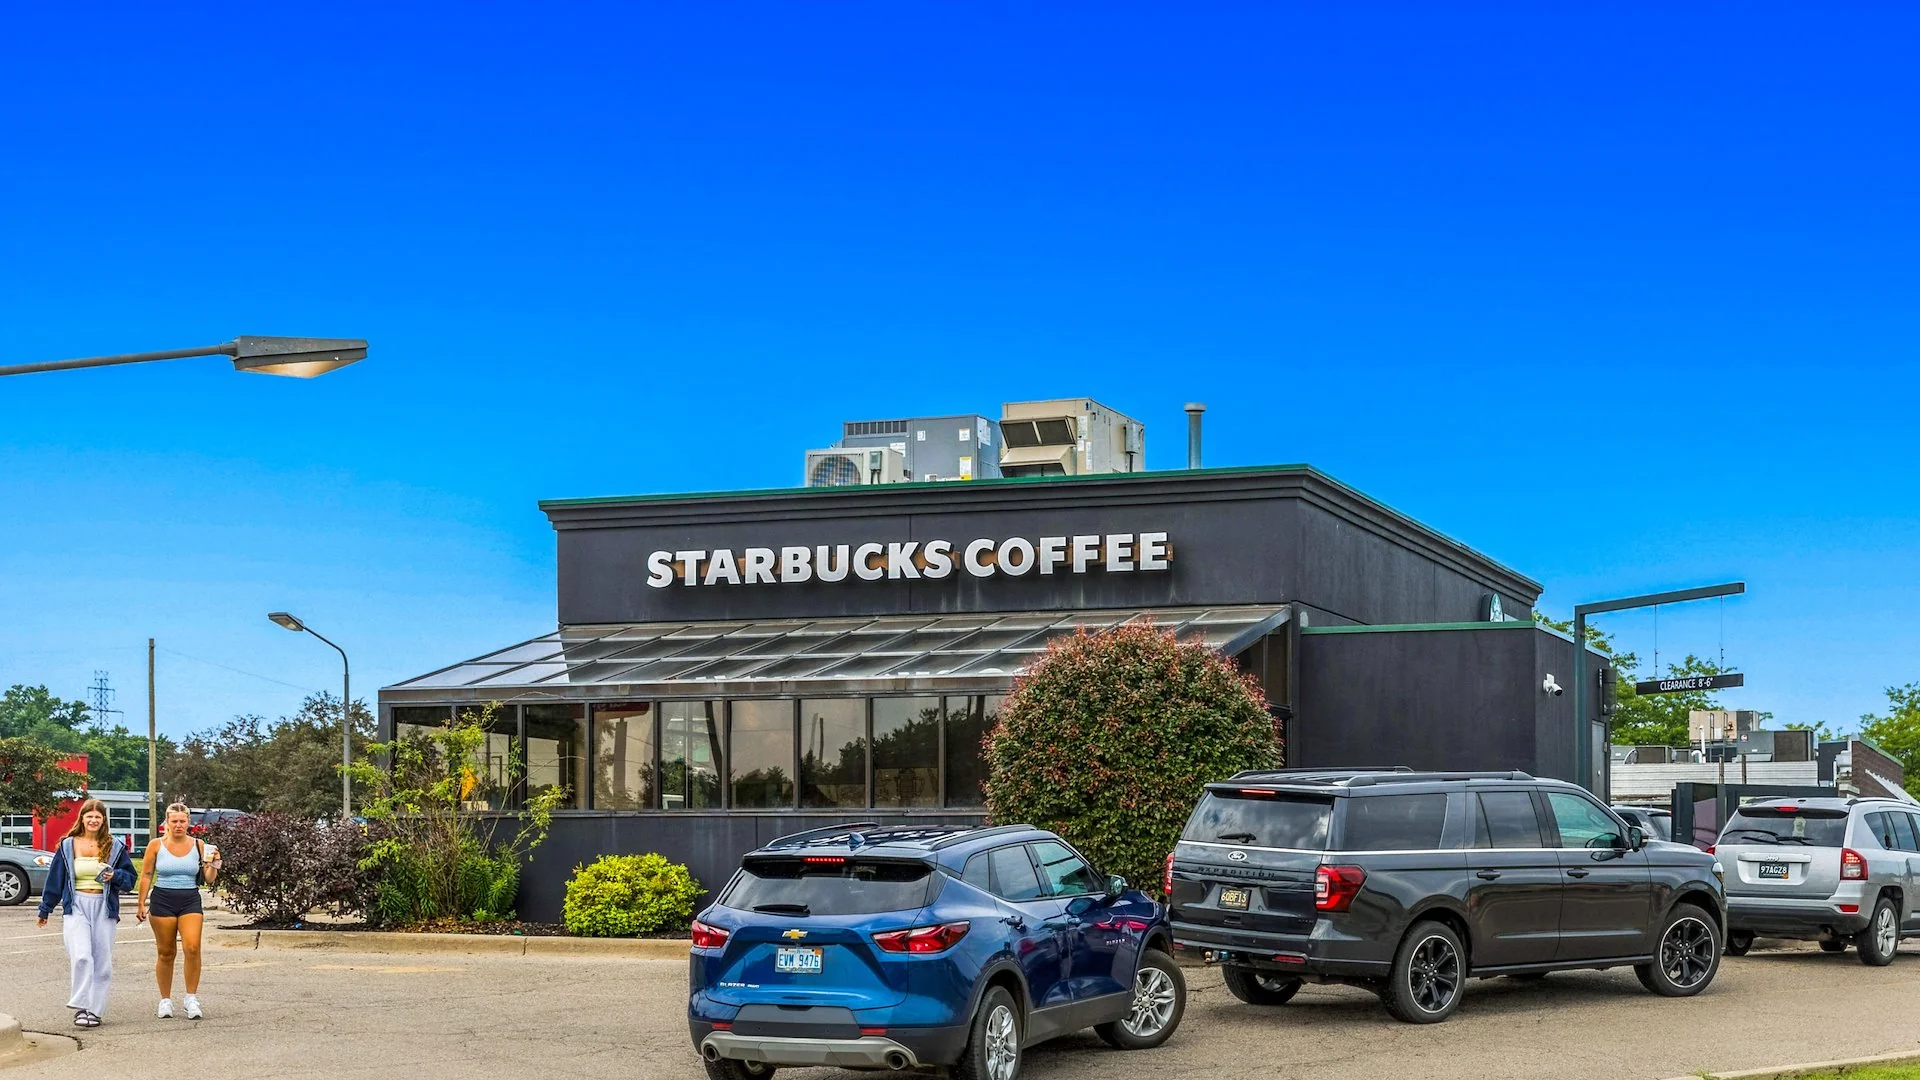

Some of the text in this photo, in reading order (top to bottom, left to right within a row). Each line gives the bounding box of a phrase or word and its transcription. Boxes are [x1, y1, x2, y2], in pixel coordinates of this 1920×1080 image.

[646, 532, 1169, 588] STARBUCKS COFFEE
[1660, 679, 1696, 691] CLEARANCE
[799, 954, 820, 967] 9476
